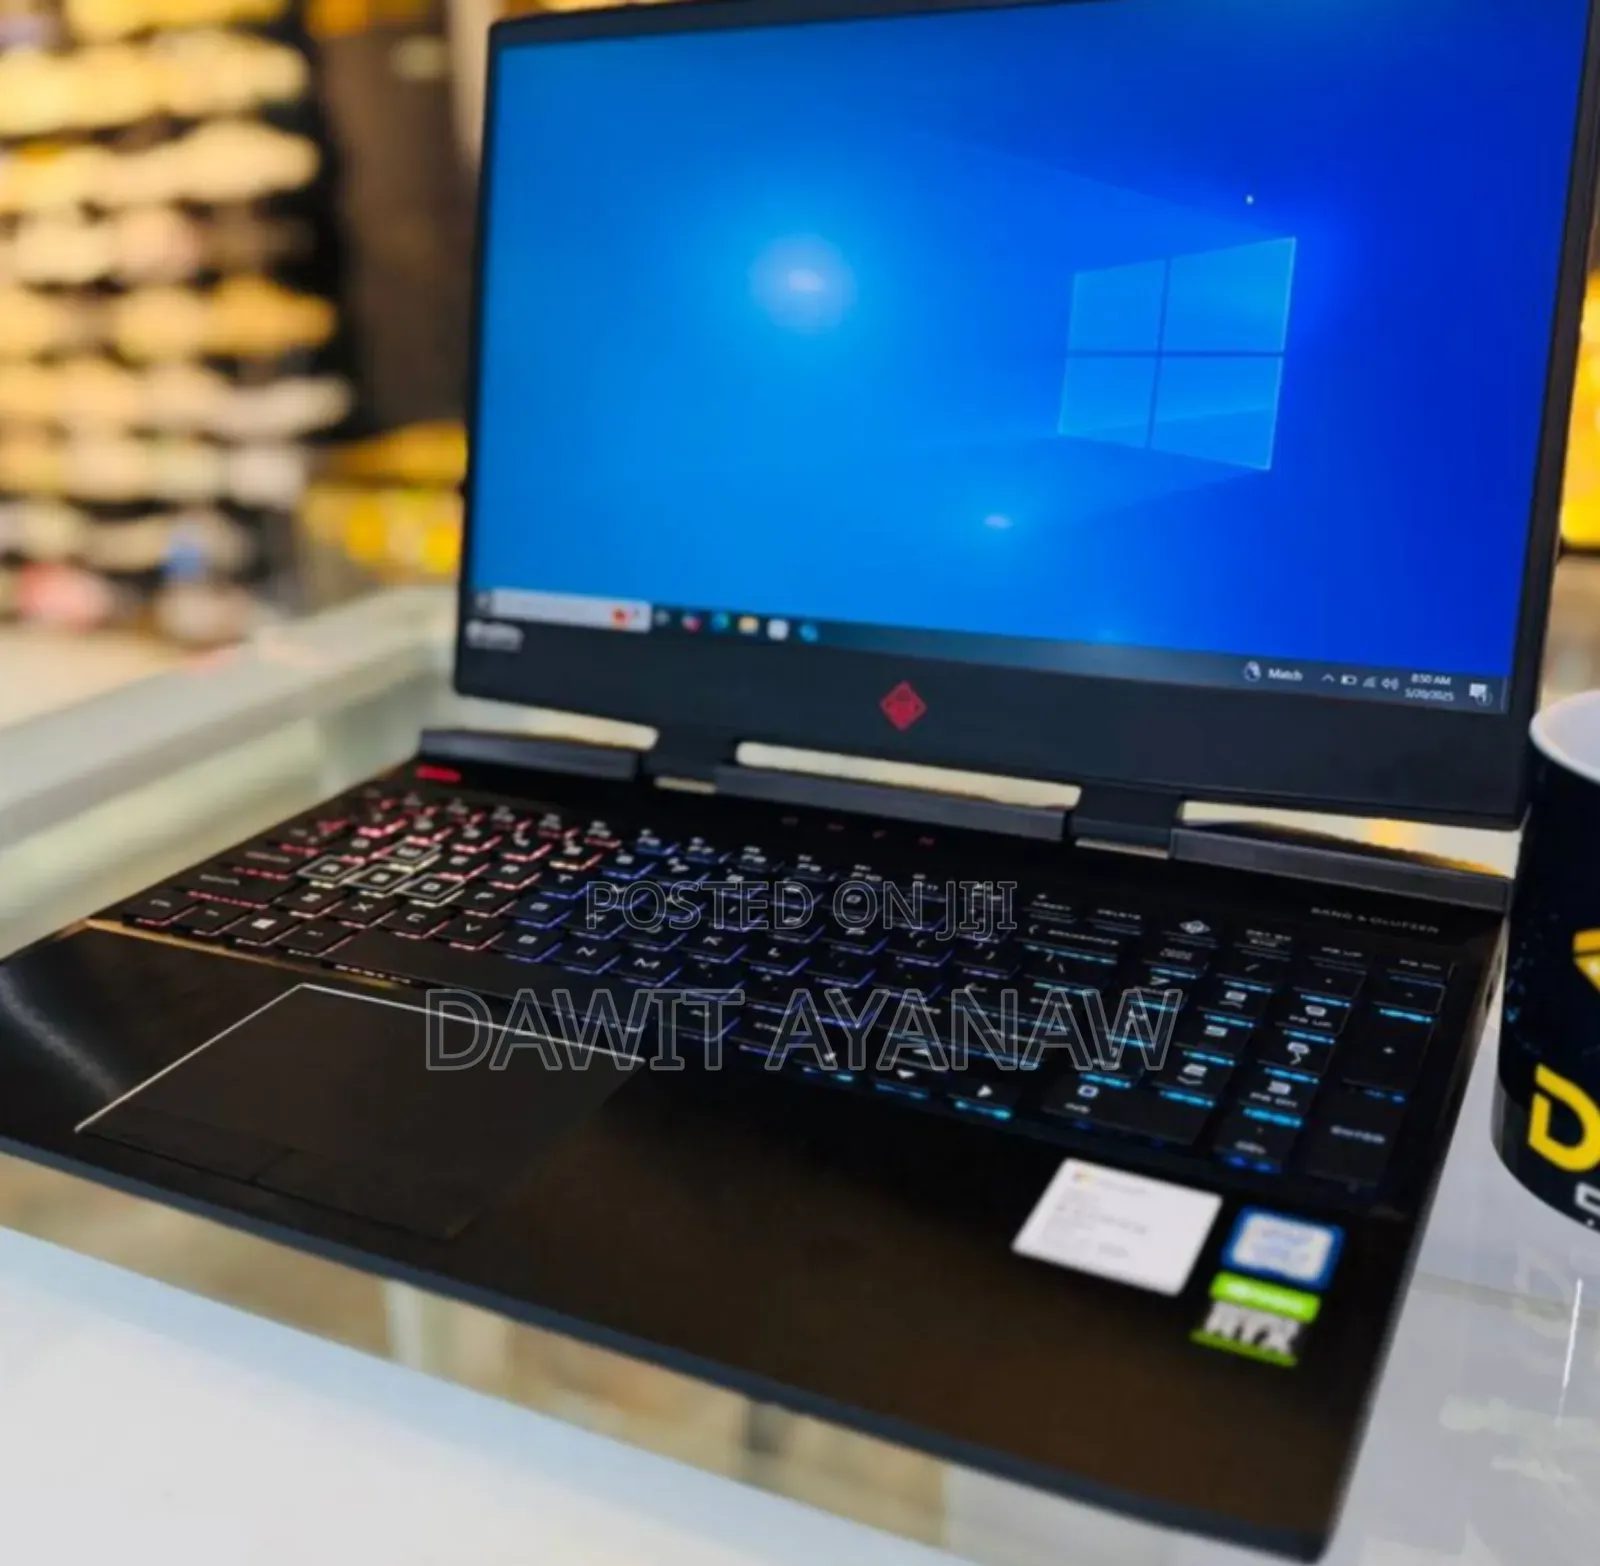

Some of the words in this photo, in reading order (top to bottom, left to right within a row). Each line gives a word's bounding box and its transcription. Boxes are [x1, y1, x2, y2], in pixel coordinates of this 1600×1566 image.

[1268, 667, 1303, 682] Match
[1433, 675, 1451, 687] AM
[1203, 1300, 1301, 1357] RTX
